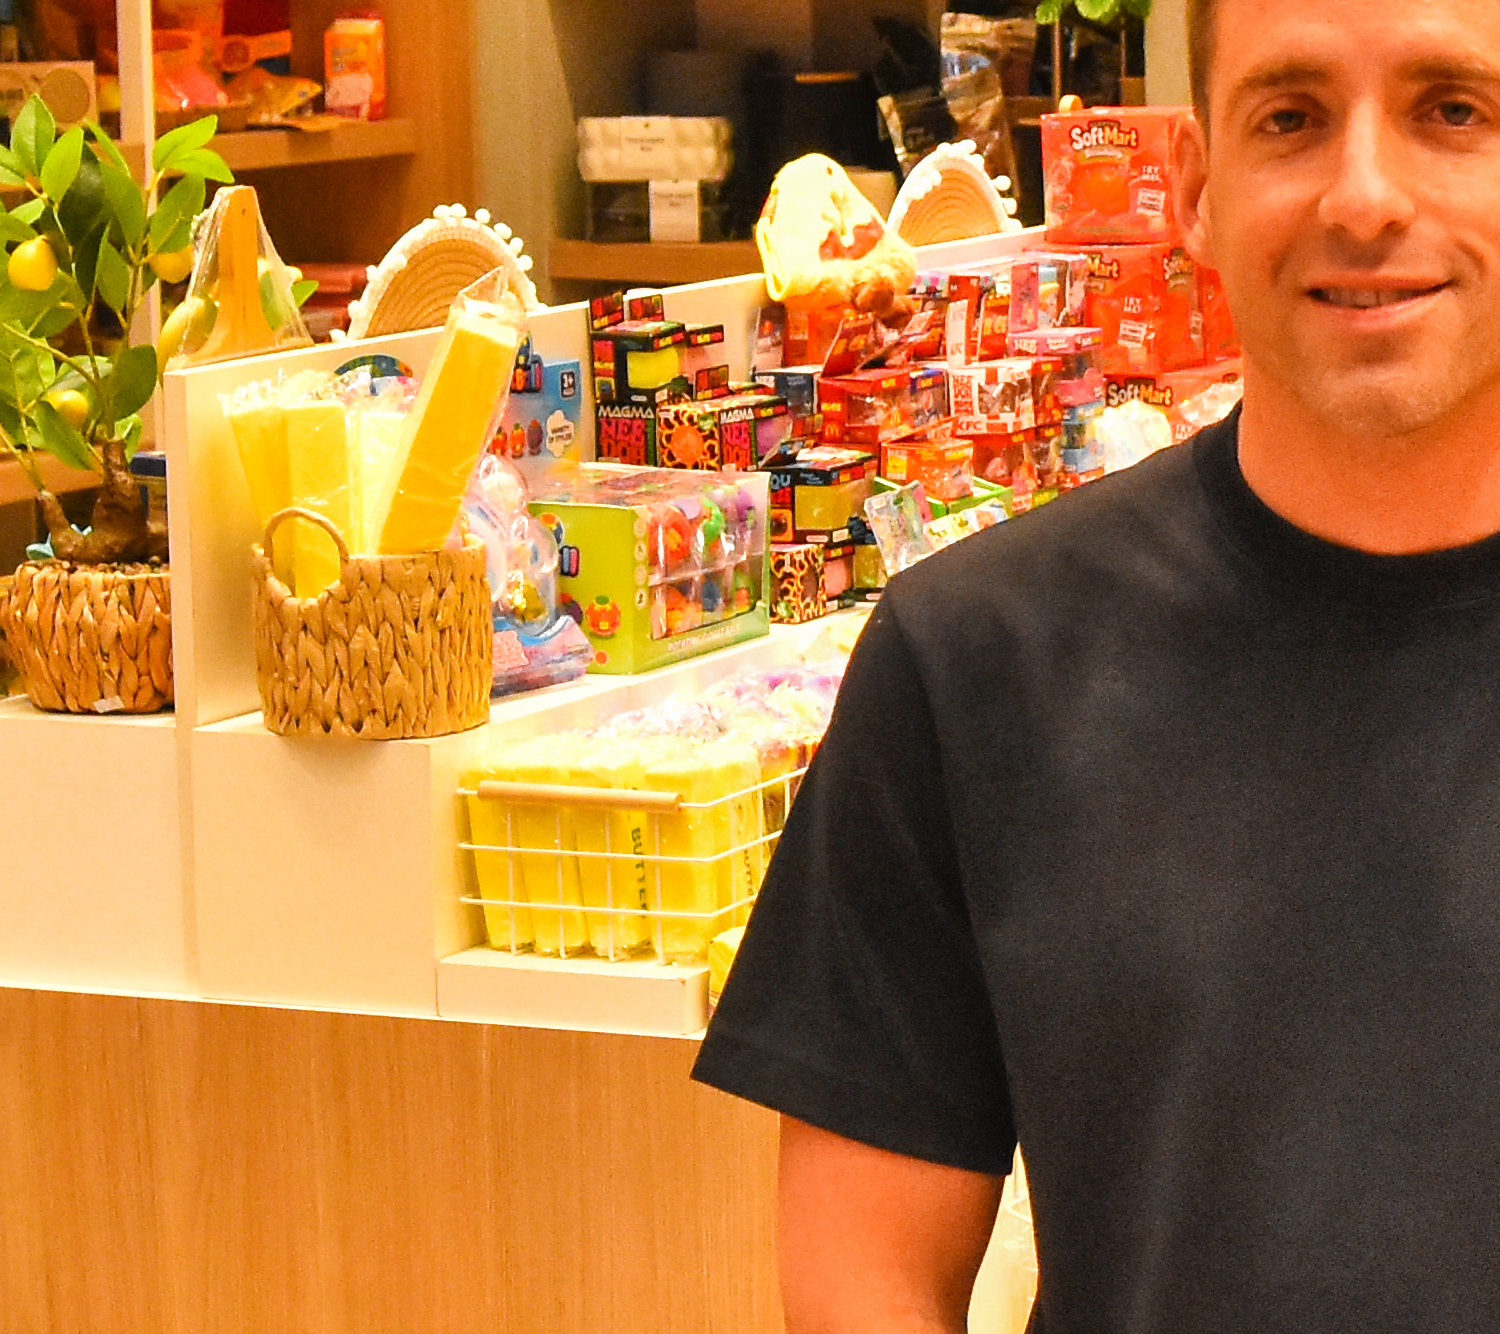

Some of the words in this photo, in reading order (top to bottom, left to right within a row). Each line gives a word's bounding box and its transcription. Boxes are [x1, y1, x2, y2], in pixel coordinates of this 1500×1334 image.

[1070, 125, 1138, 151] SoftMart
[1087, 255, 1120, 279] Mart
[1107, 381, 1173, 407] SoftMart
[598, 405, 655, 419] MAGMA
[720, 407, 755, 425] MAGMA
